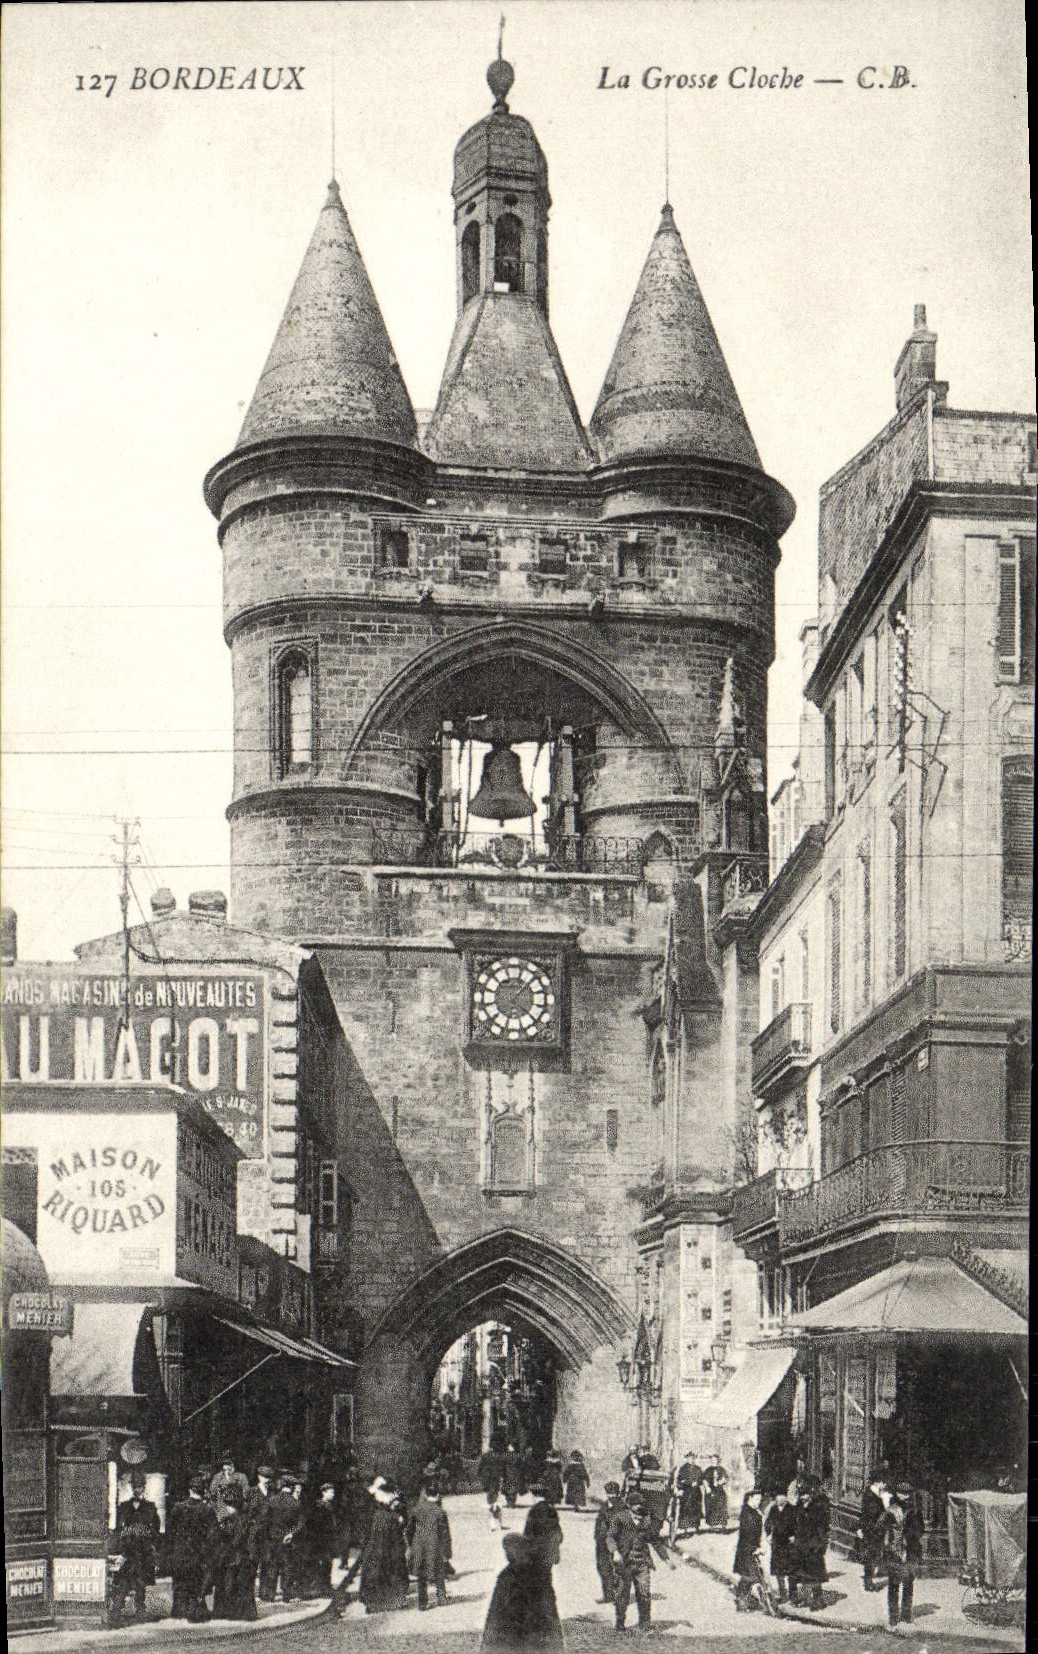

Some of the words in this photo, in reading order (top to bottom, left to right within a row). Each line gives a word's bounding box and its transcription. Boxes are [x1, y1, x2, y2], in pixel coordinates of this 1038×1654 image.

[134, 982, 153, 1006] de
[74, 1016, 260, 1092] MAGOT
[50, 1147, 161, 1182] MAISON
[42, 1189, 165, 1235] RIQUARD
